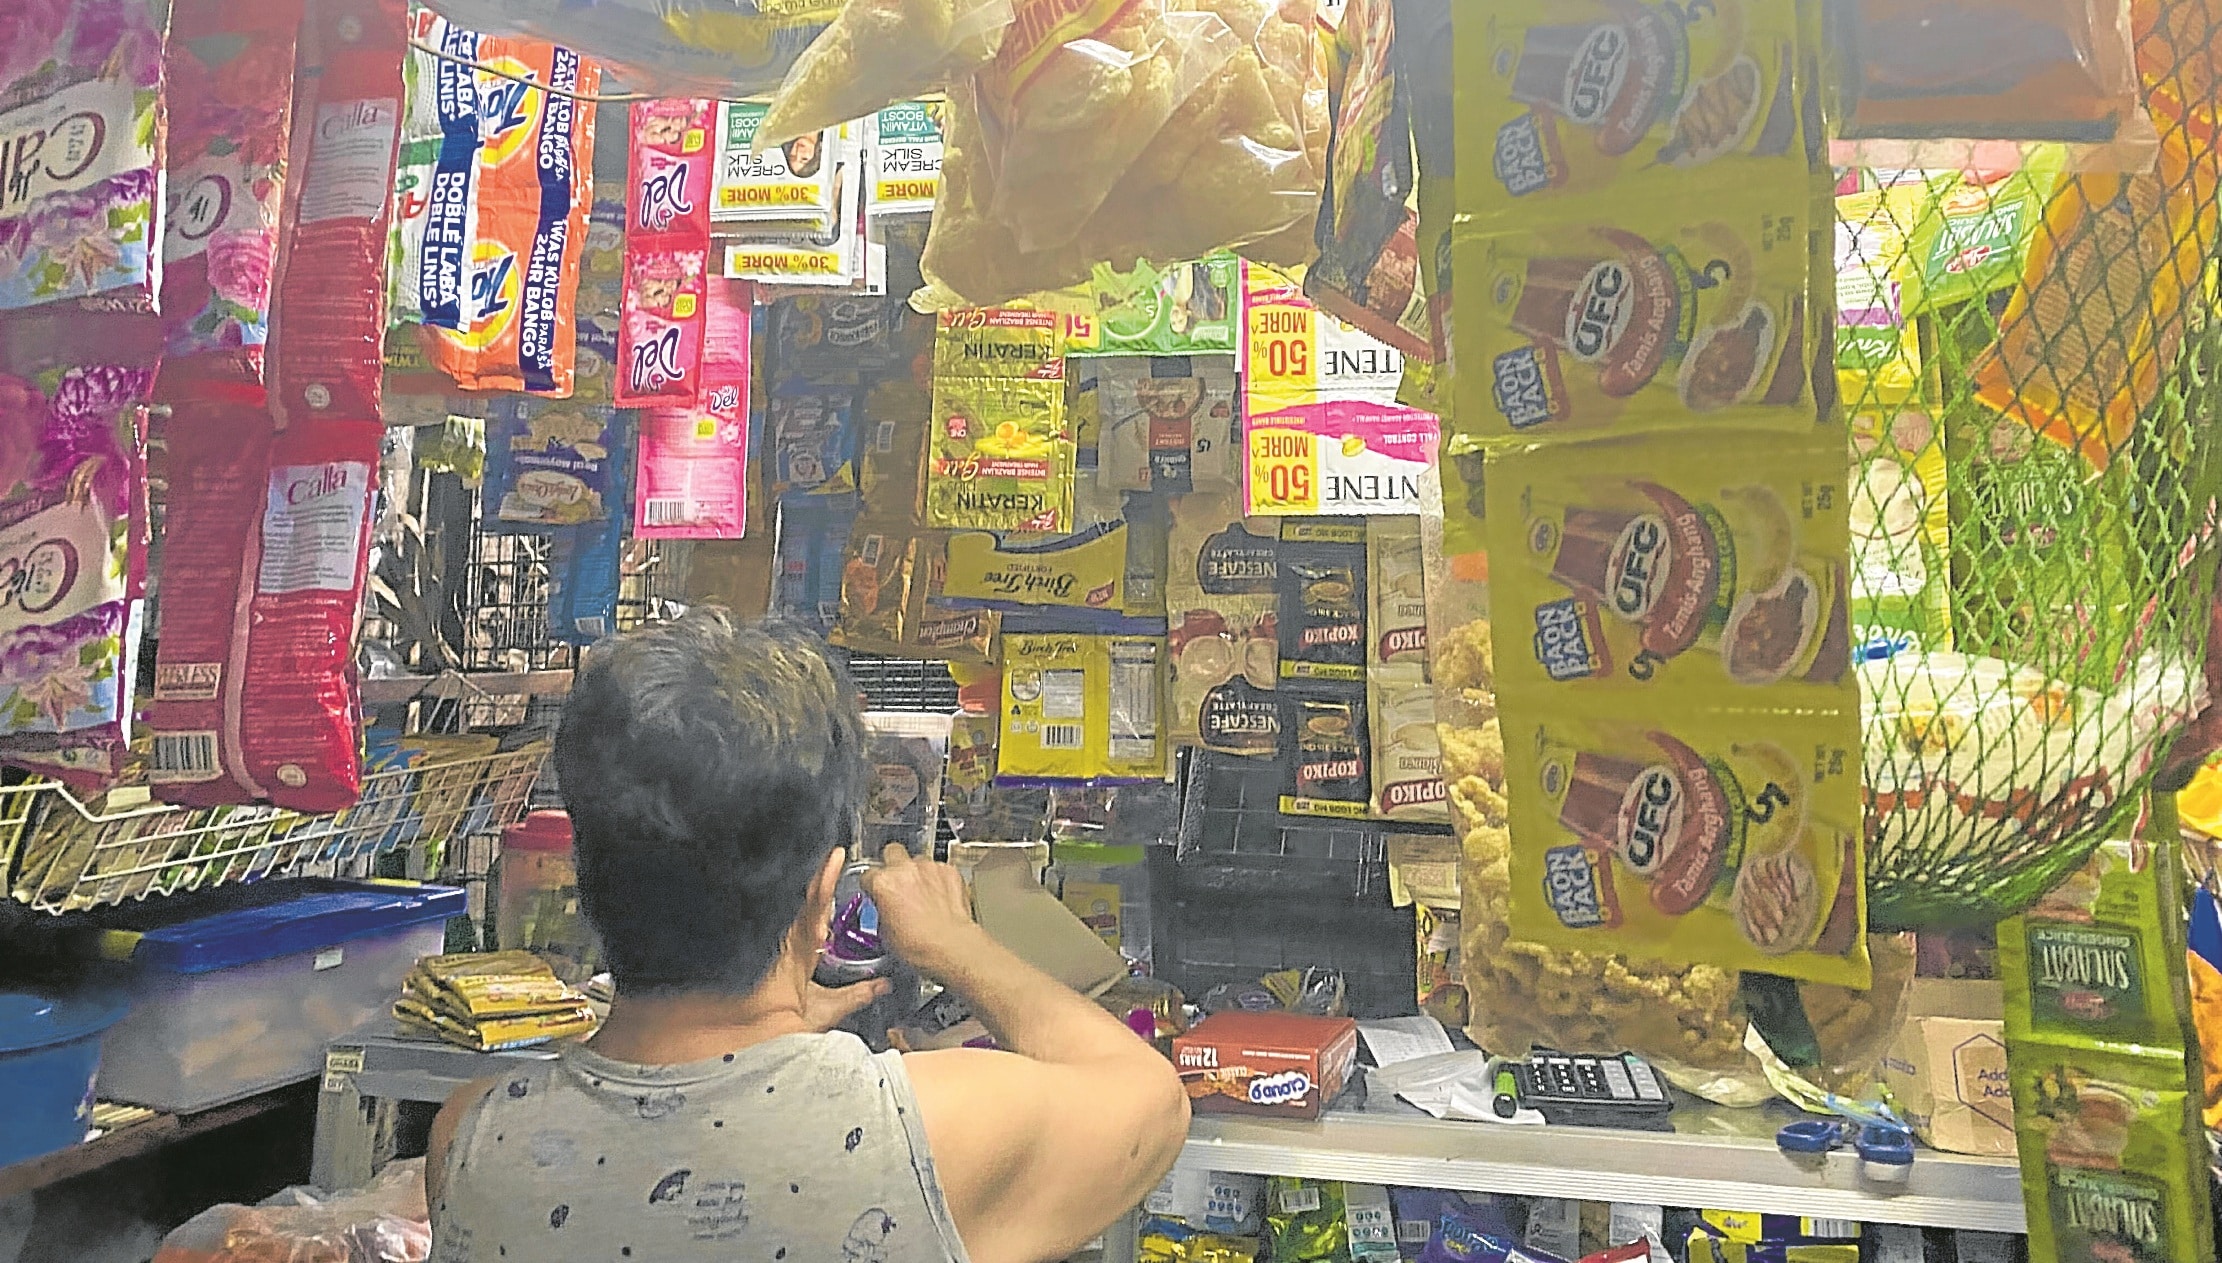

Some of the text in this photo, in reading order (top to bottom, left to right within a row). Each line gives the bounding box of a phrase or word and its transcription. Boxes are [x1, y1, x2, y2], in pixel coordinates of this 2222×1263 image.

[1572, 29, 1620, 119] UFC
[881, 110, 924, 122] BOOST
[881, 120, 928, 132] VITAMIN
[540, 101, 559, 169] BANGO
[882, 158, 943, 174] CREAM
[885, 149, 923, 162] SILK
[727, 164, 786, 178] CREAM
[640, 163, 692, 228] Del
[727, 186, 809, 202] 30% MORE
[885, 181, 934, 197] MORE
[424, 172, 448, 242] DOBLE
[437, 172, 466, 306] DOBLE LABA
[741, 255, 830, 270] 30% MORE
[521, 234, 549, 358] 24HR BANGO
[540, 264, 560, 322] KULOB
[1575, 265, 1623, 357] UFC
[538, 322, 553, 350] PARA
[631, 327, 683, 391] Del
[964, 343, 1050, 360] KERATIN
[1621, 331, 1660, 377] Tamis
[711, 385, 739, 411] Del
[1500, 350, 1548, 424] BAON PACK
[1383, 433, 1417, 444] CONTROL
[288, 463, 348, 506] Calla
[981, 466, 1016, 476] BRAZILIAN
[1255, 464, 1310, 502] 50%
[1326, 474, 1419, 501] NTENE
[957, 492, 1043, 511] KERATIN
[1615, 519, 1660, 614] UFC
[1662, 511, 1712, 641] Tamis Anghang
[983, 572, 1077, 599] Birch Tree
[1304, 624, 1358, 645] KOPIKO
[1389, 629, 1425, 652] PIKO
[1538, 602, 1589, 680] BAON PACK
[1303, 760, 1358, 781] KOPIKO
[1391, 779, 1445, 804] OPIKO
[1627, 773, 1673, 869] UFC
[1548, 849, 1599, 924] BAON PACK
[2039, 943, 2130, 989] SALABAT
[1179, 1046, 1219, 1068] 12 BARS
[1251, 1077, 1307, 1100] CLOUD 9
[2065, 1191, 2158, 1243] SALABAT
